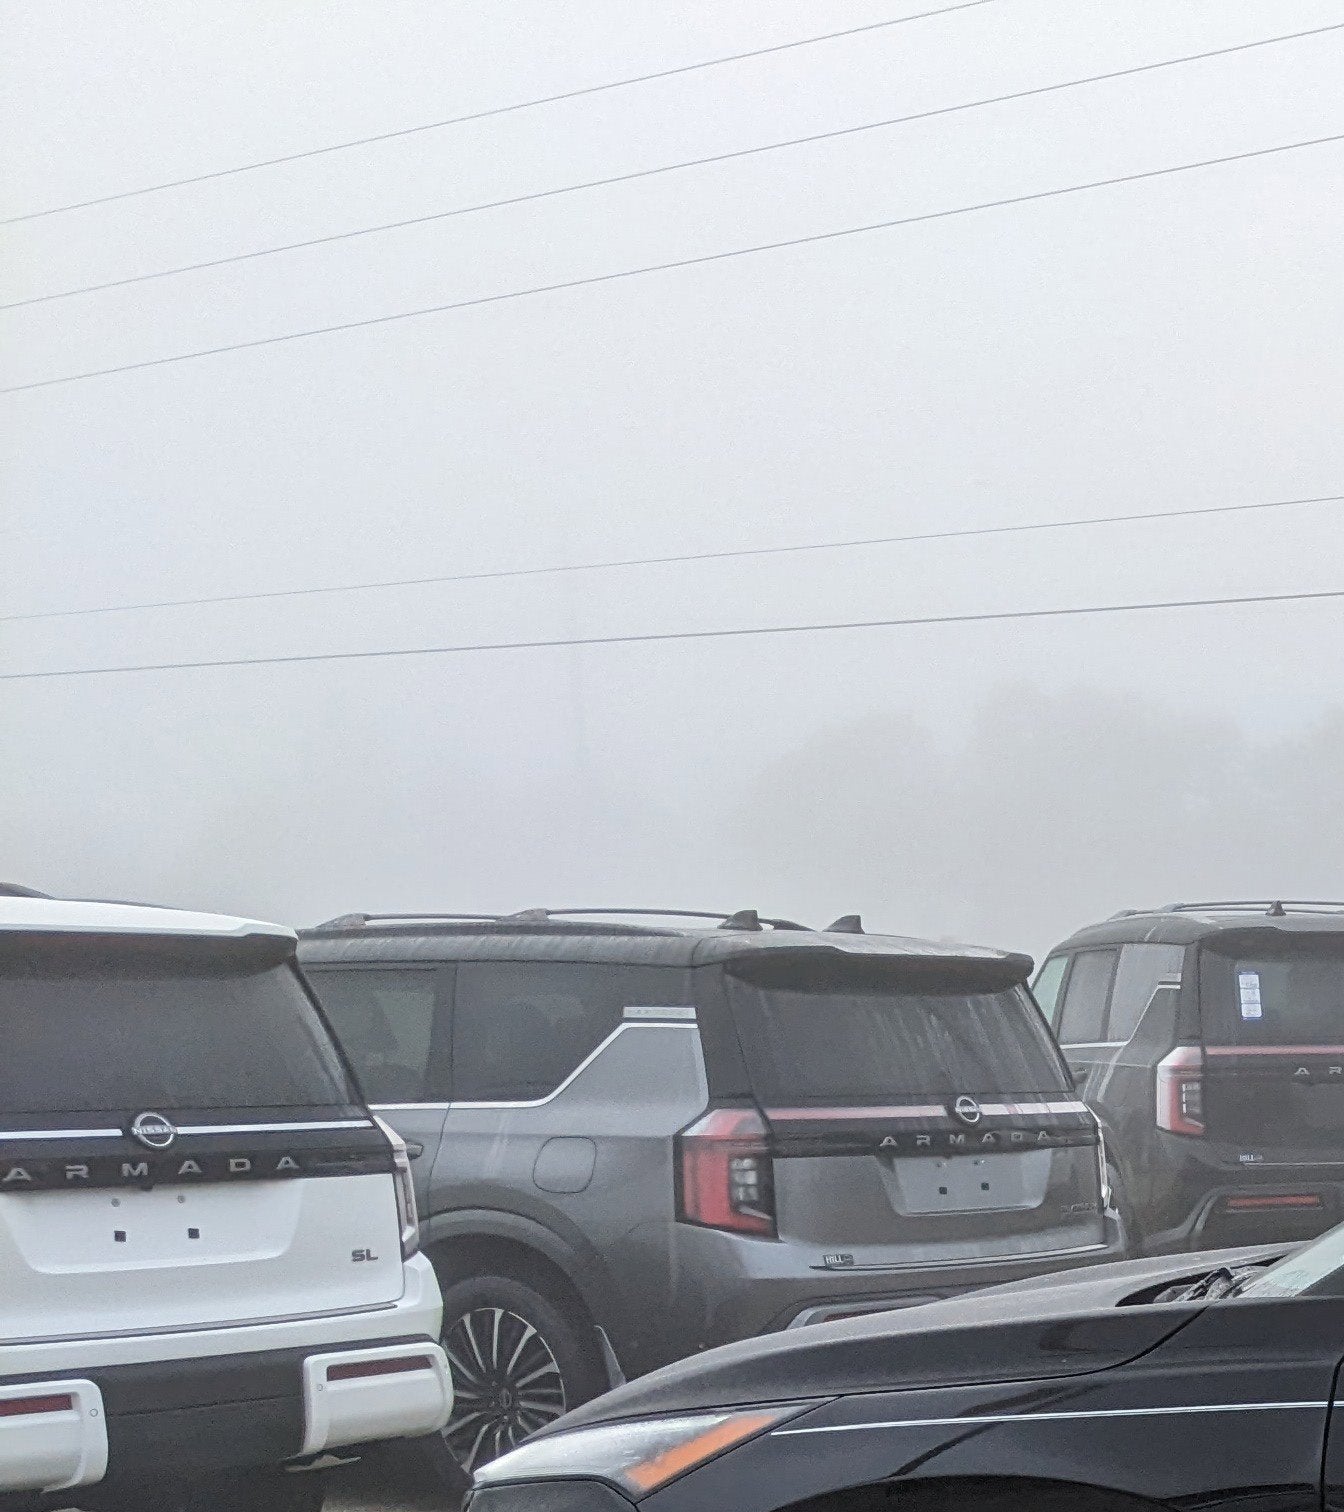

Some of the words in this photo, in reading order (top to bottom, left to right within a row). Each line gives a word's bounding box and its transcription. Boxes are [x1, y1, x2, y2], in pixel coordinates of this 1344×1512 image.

[880, 1130, 1049, 1147] ARMADA
[2, 1156, 300, 1183] ARMADA
[351, 1248, 379, 1263] SL
